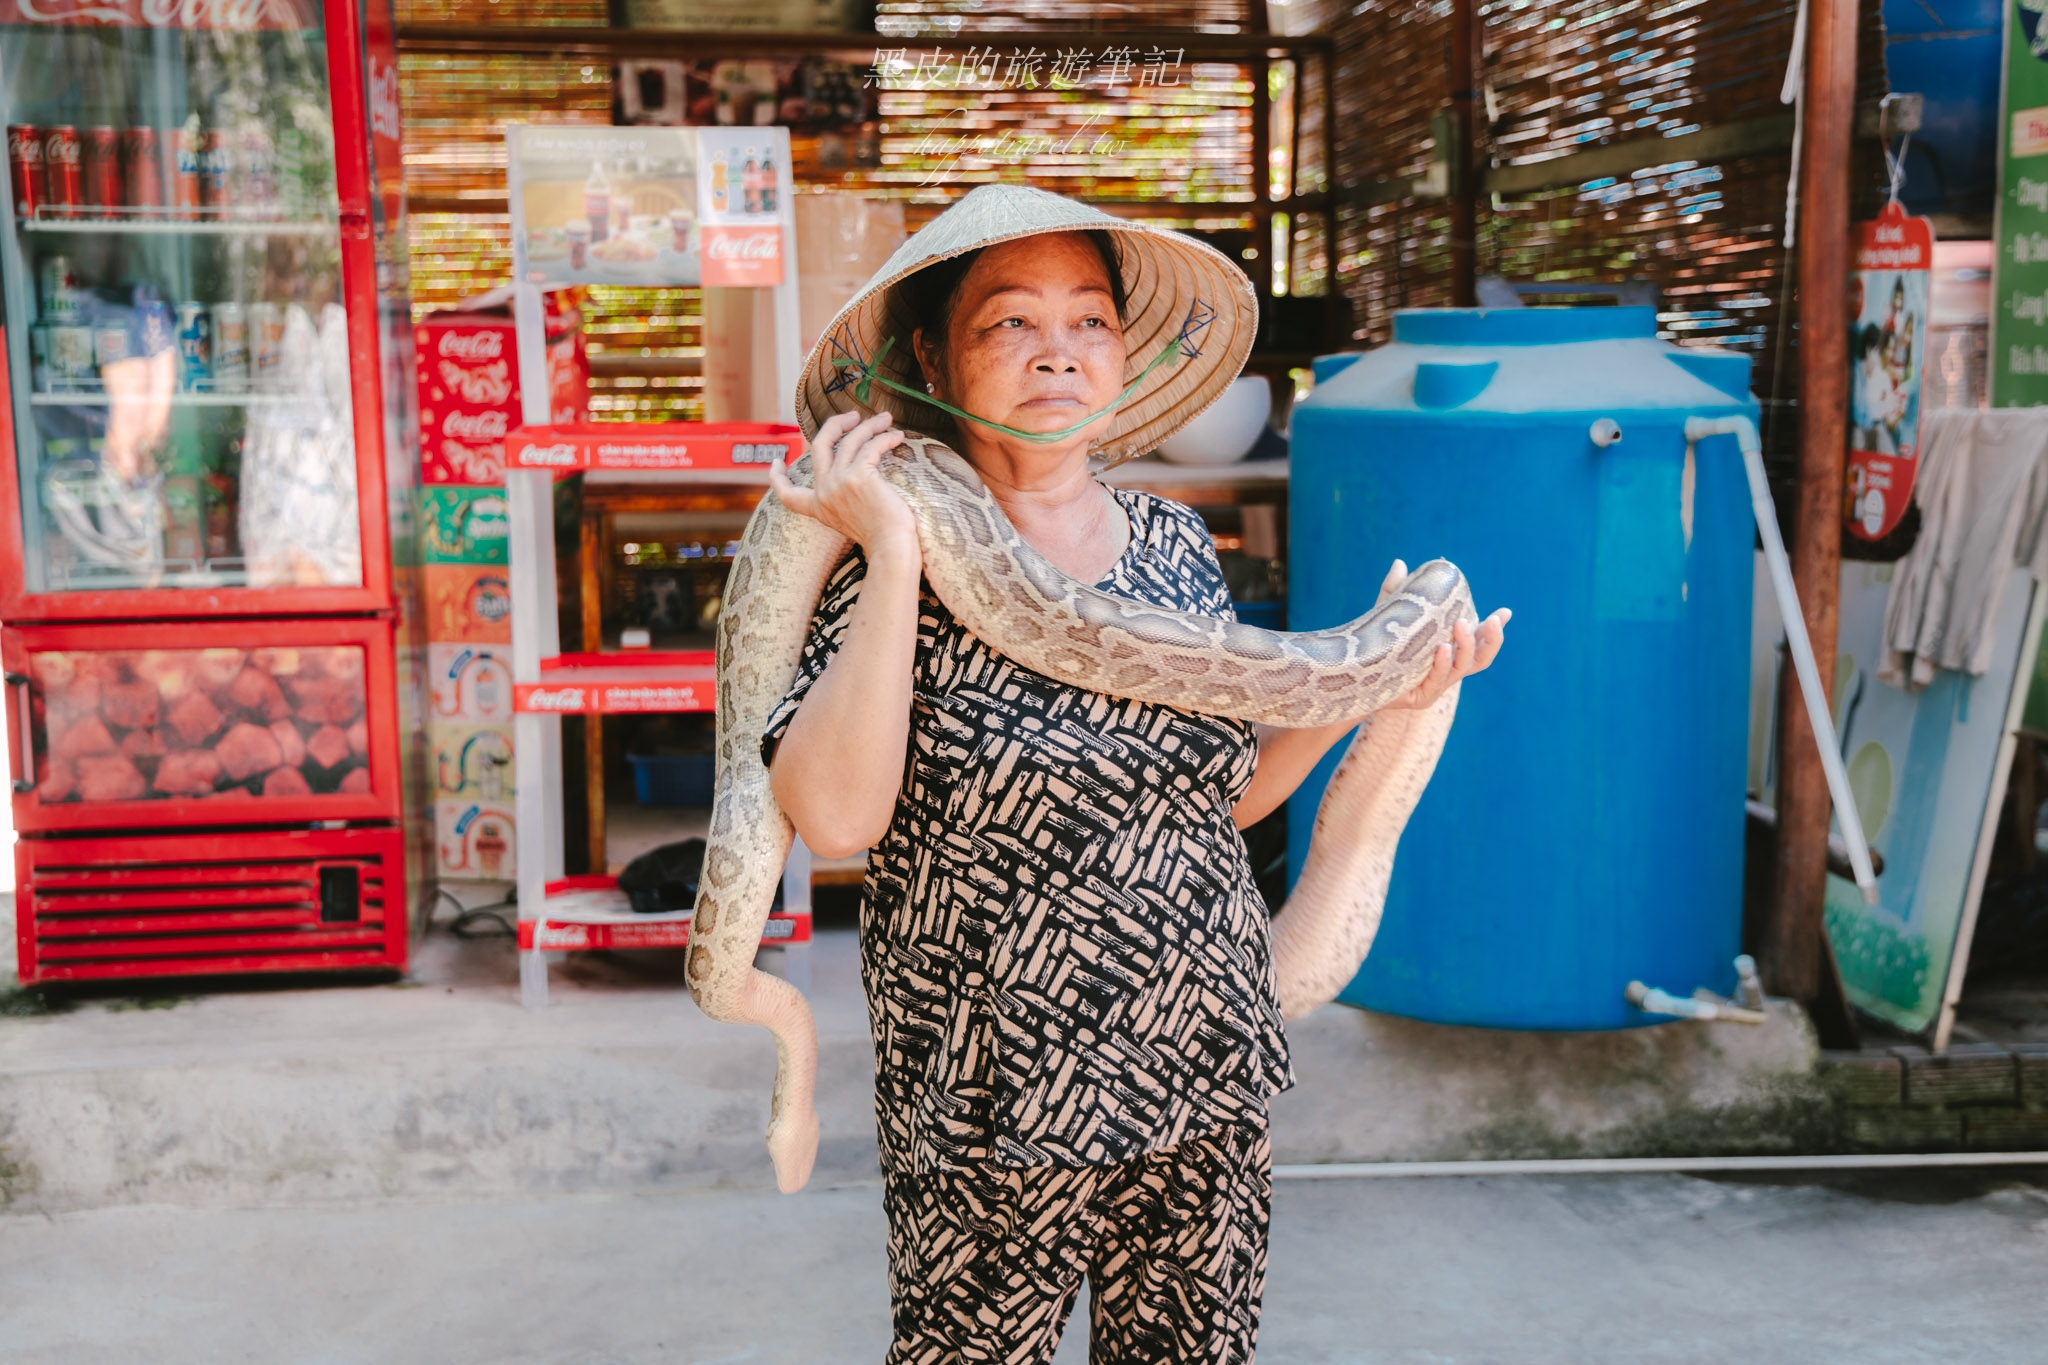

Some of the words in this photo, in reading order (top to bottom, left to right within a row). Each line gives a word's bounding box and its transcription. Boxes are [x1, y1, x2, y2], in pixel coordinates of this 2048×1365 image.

[709, 231, 779, 260] Coca-Cola
[438, 330, 503, 358] Coca-Cola
[442, 409, 509, 438] Coca-Cola
[519, 443, 577, 466] Coca-Cola
[528, 688, 584, 710] Coca-Cola
